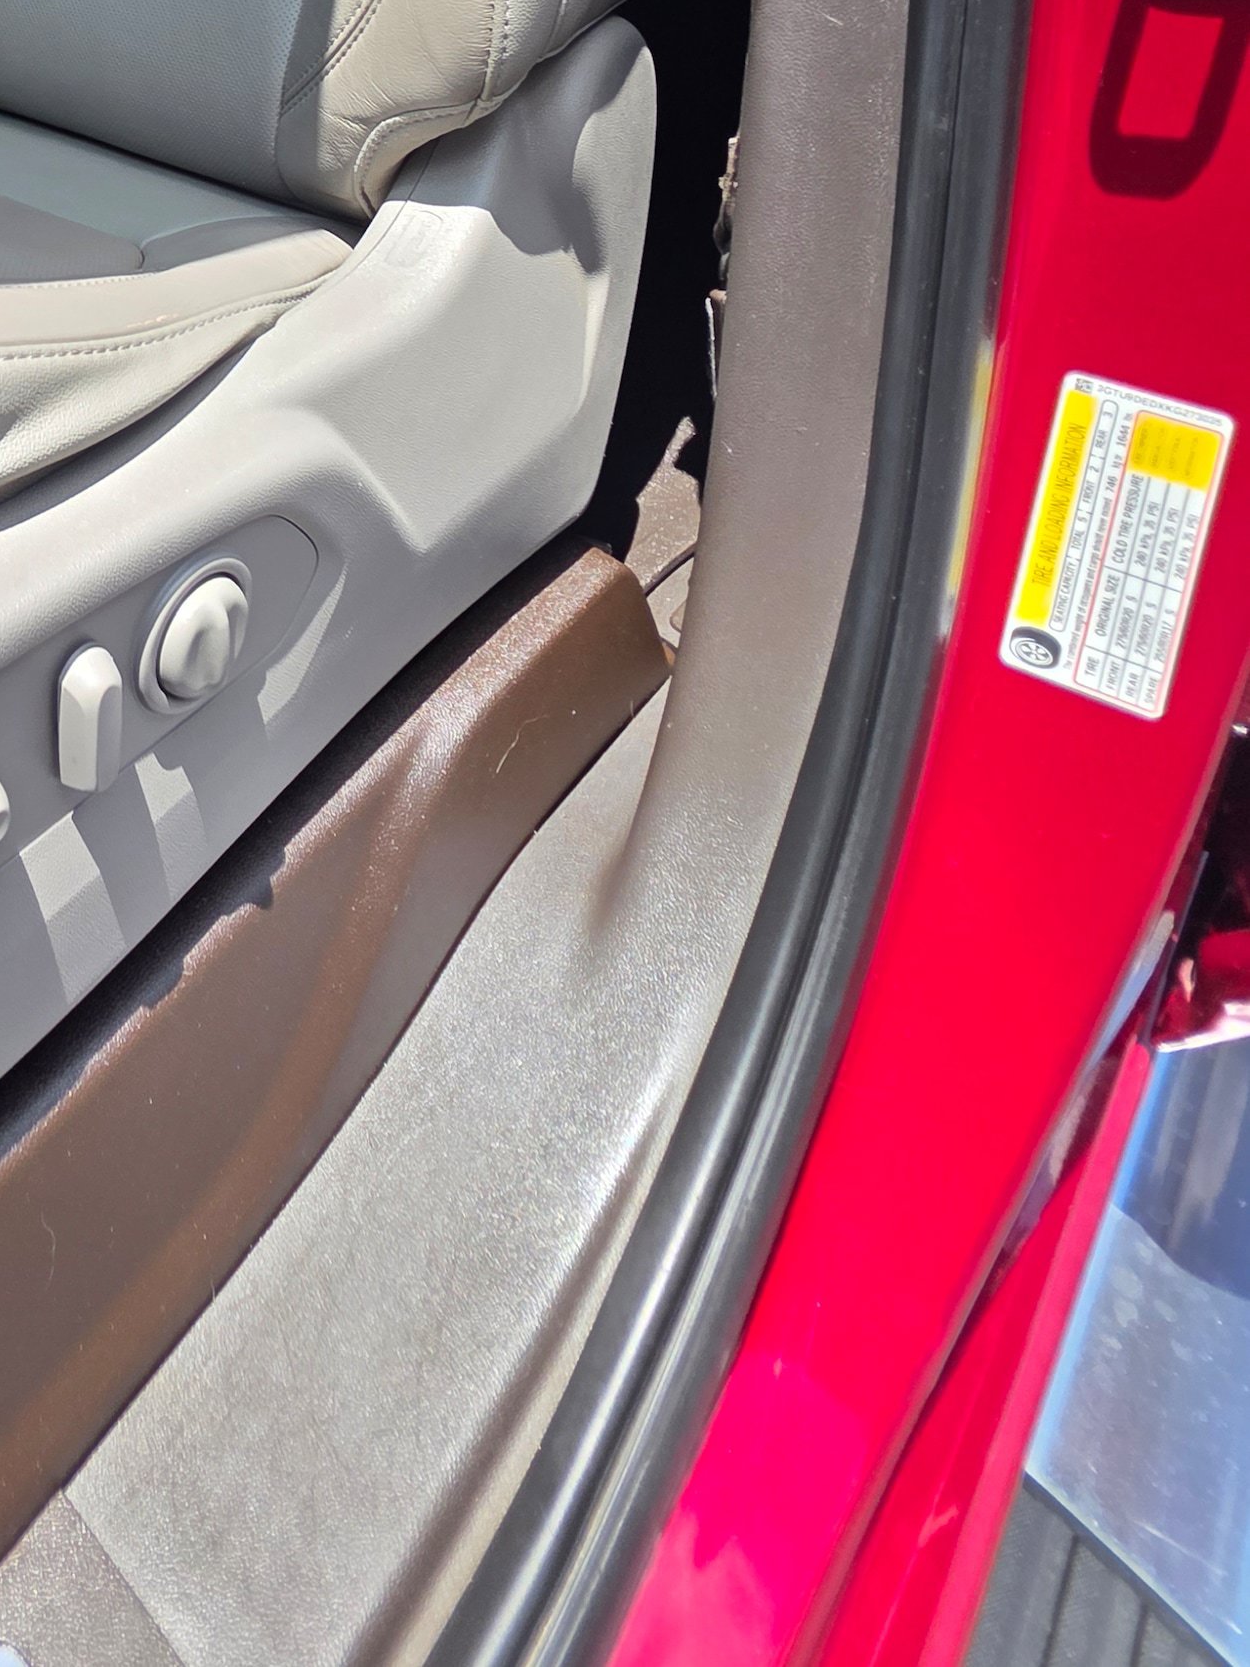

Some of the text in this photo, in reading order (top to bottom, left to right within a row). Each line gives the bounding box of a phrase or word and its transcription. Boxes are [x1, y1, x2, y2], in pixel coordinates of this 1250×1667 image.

[1096, 429, 1107, 448] REAR
[1083, 481, 1095, 503] FRONT
[1123, 474, 1142, 518] PRESSURE
[1032, 422, 1086, 587] TIRE AND LOADING INFORMATION
[1072, 529, 1083, 549] TOTAL
[1118, 519, 1132, 537] TIRE
[1112, 539, 1127, 563] COLD
[1054, 562, 1076, 623] SEATING CAPACITY
[1104, 573, 1118, 594] SIZE
[1094, 595, 1113, 637] ORIGINAL
[1085, 656, 1098, 677] TIRE
